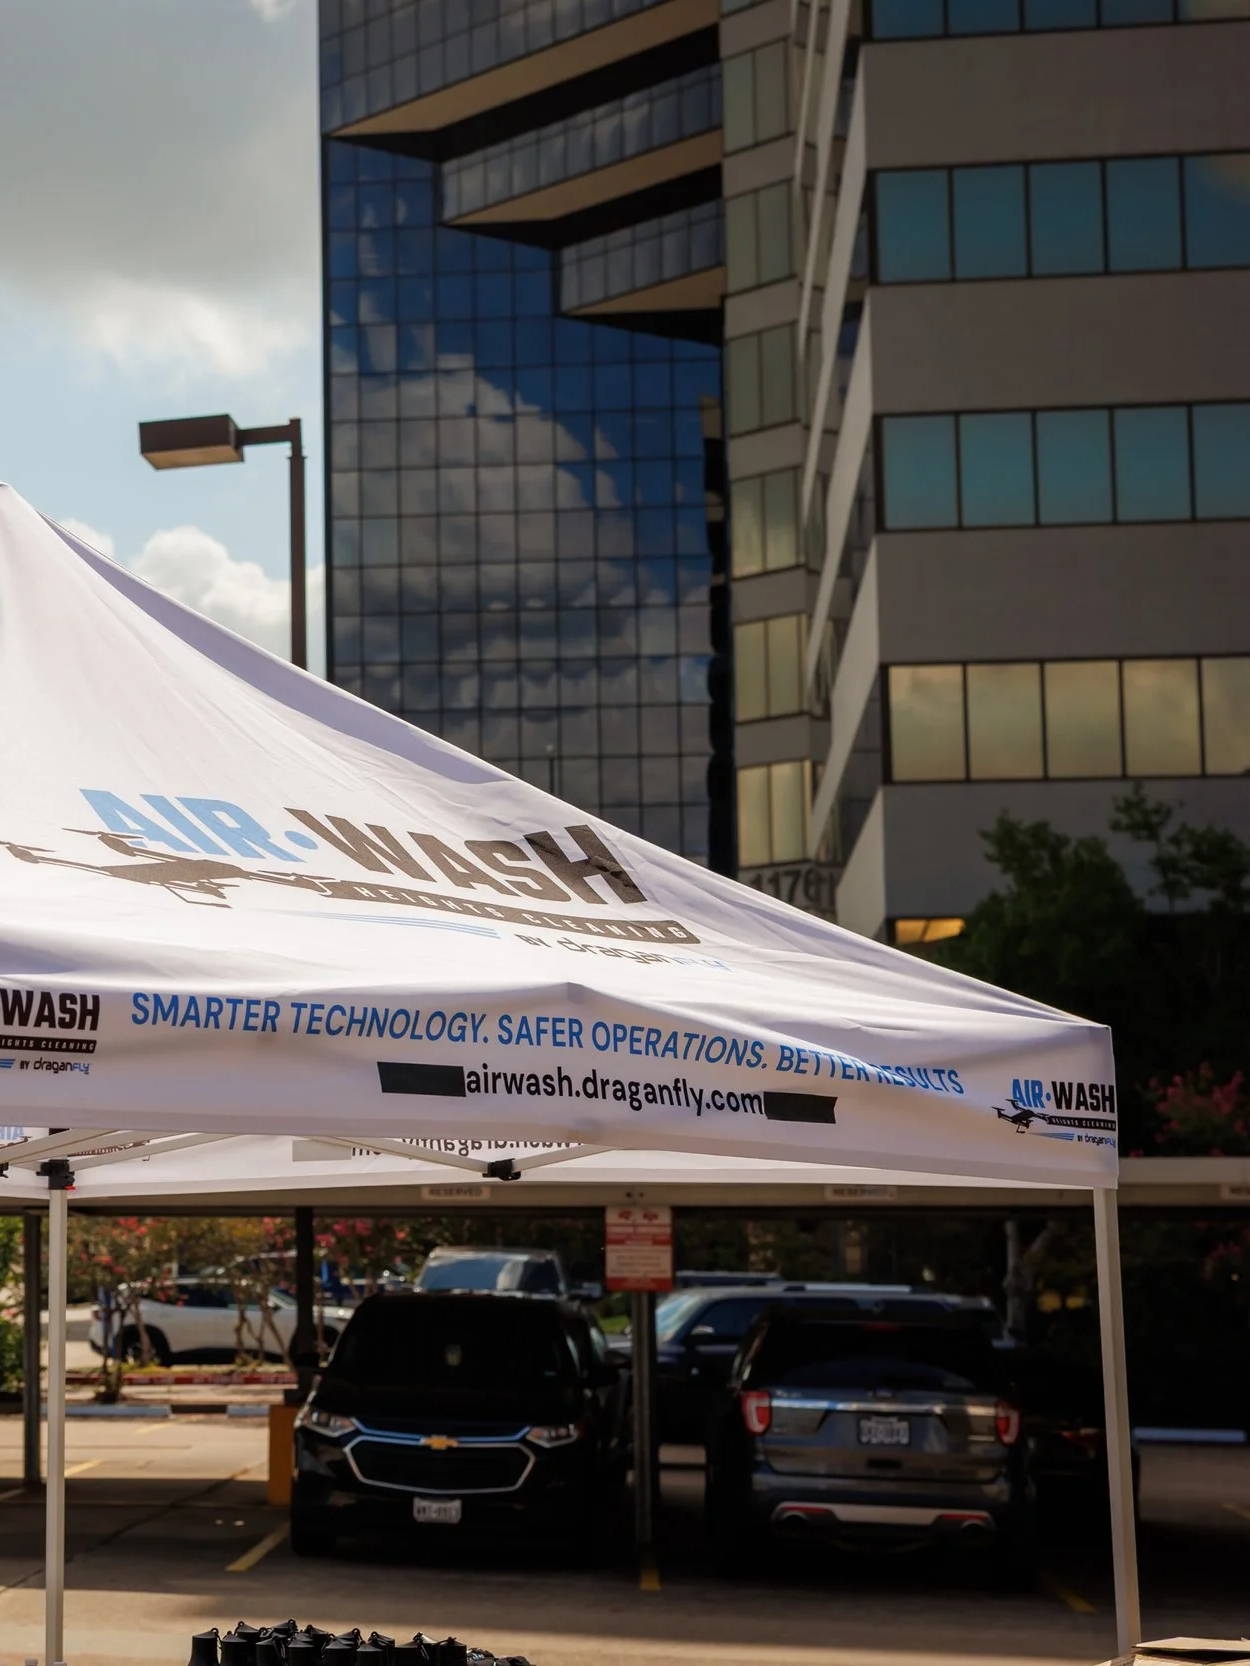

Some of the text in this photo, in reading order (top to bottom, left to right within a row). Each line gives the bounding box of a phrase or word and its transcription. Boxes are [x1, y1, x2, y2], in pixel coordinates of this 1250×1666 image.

[353, 886, 691, 940] HEIGHTS CLEANING
[513, 933, 553, 949] BY
[41, 1040, 95, 1051] CLEANING
[131, 992, 966, 1095] SMARTER TECHNOLOGY. SAFER OPERATIONS. BETTER RESULTS
[466, 1062, 765, 1118] airwash.draganfly.com
